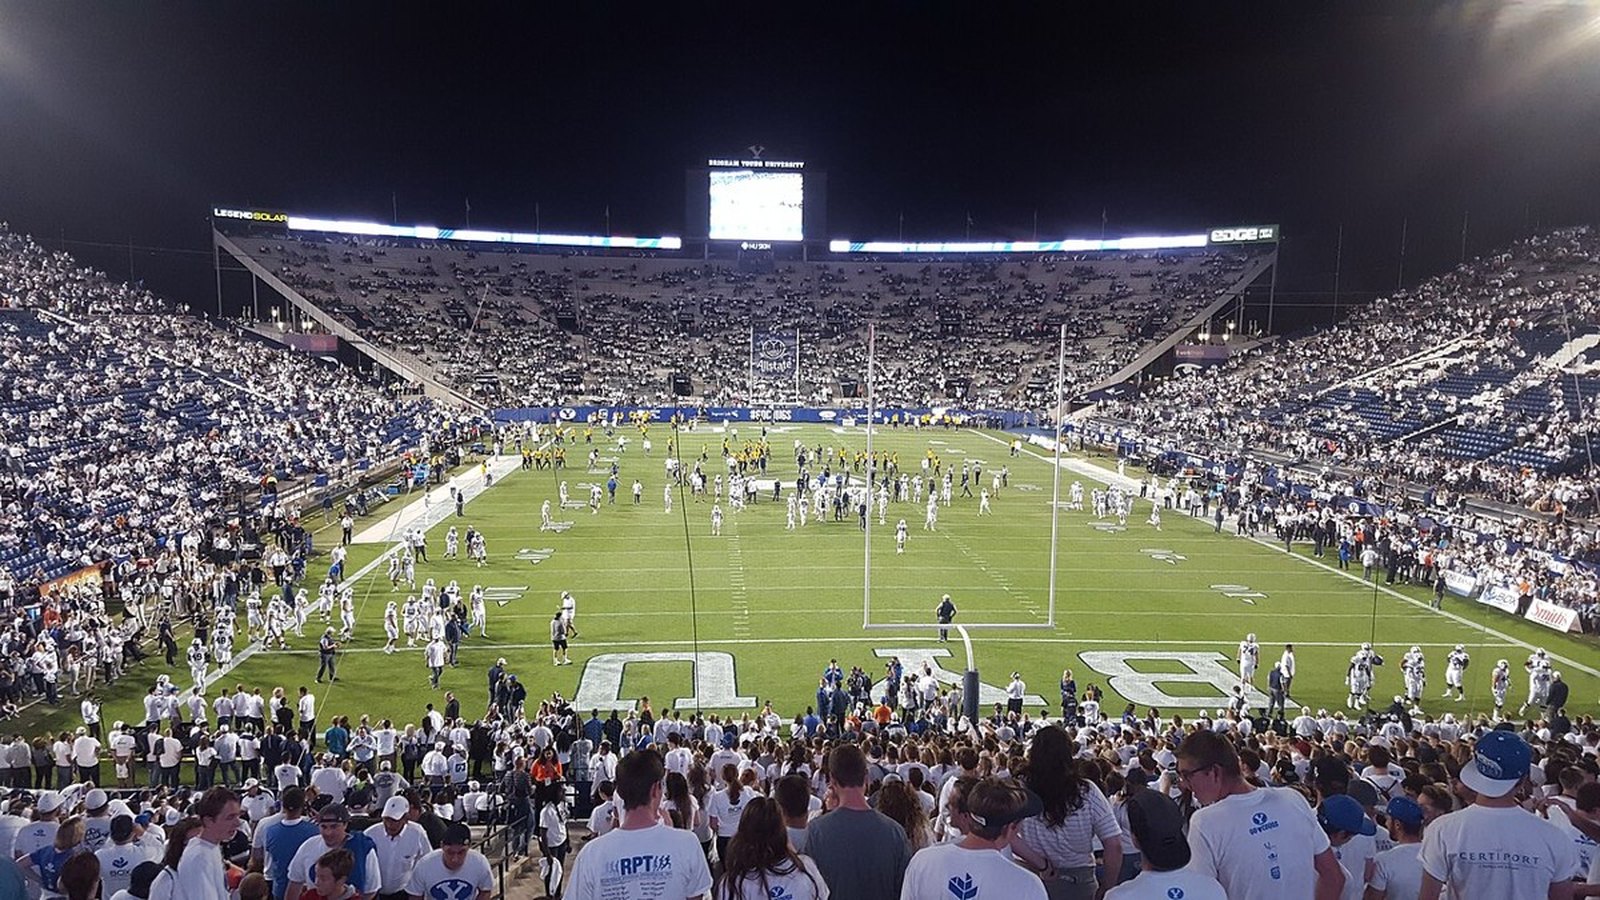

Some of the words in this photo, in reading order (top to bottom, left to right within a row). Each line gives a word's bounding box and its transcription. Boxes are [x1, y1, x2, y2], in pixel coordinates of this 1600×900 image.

[741, 160, 763, 168] YOUNG
[756, 359, 792, 373] Allstate
[1495, 593, 1516, 606] BOX
[1531, 602, 1568, 625] Smith's
[1242, 645, 1254, 656] 74
[620, 855, 653, 875] RPT
[1459, 851, 1540, 865] CERTIPORT
